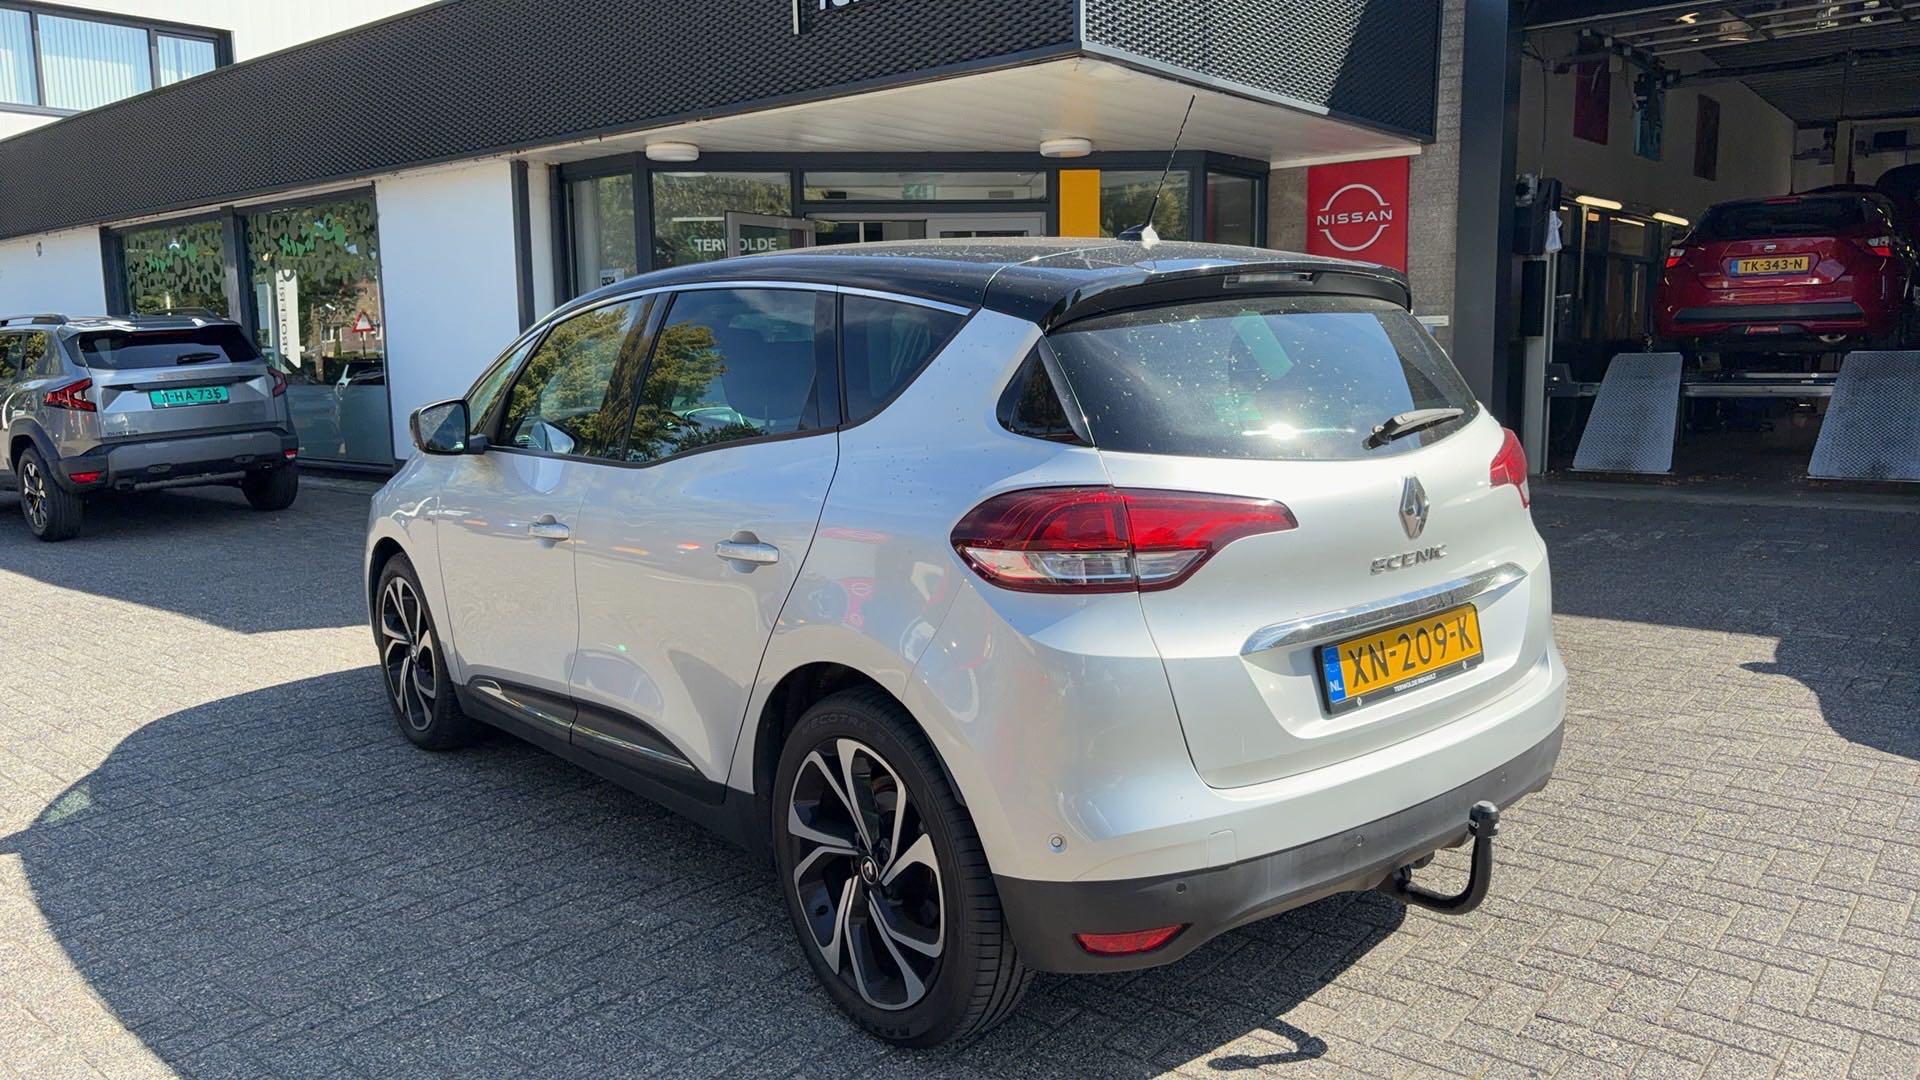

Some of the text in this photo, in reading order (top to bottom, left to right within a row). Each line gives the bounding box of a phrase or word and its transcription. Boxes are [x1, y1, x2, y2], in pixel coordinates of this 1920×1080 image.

[1317, 210, 1392, 225] NISSAN
[1743, 258, 1803, 271] TK-343-N
[1370, 544, 1447, 575] SCENIC
[1348, 613, 1474, 688] XN-209-K
[1329, 680, 1343, 692] NL
